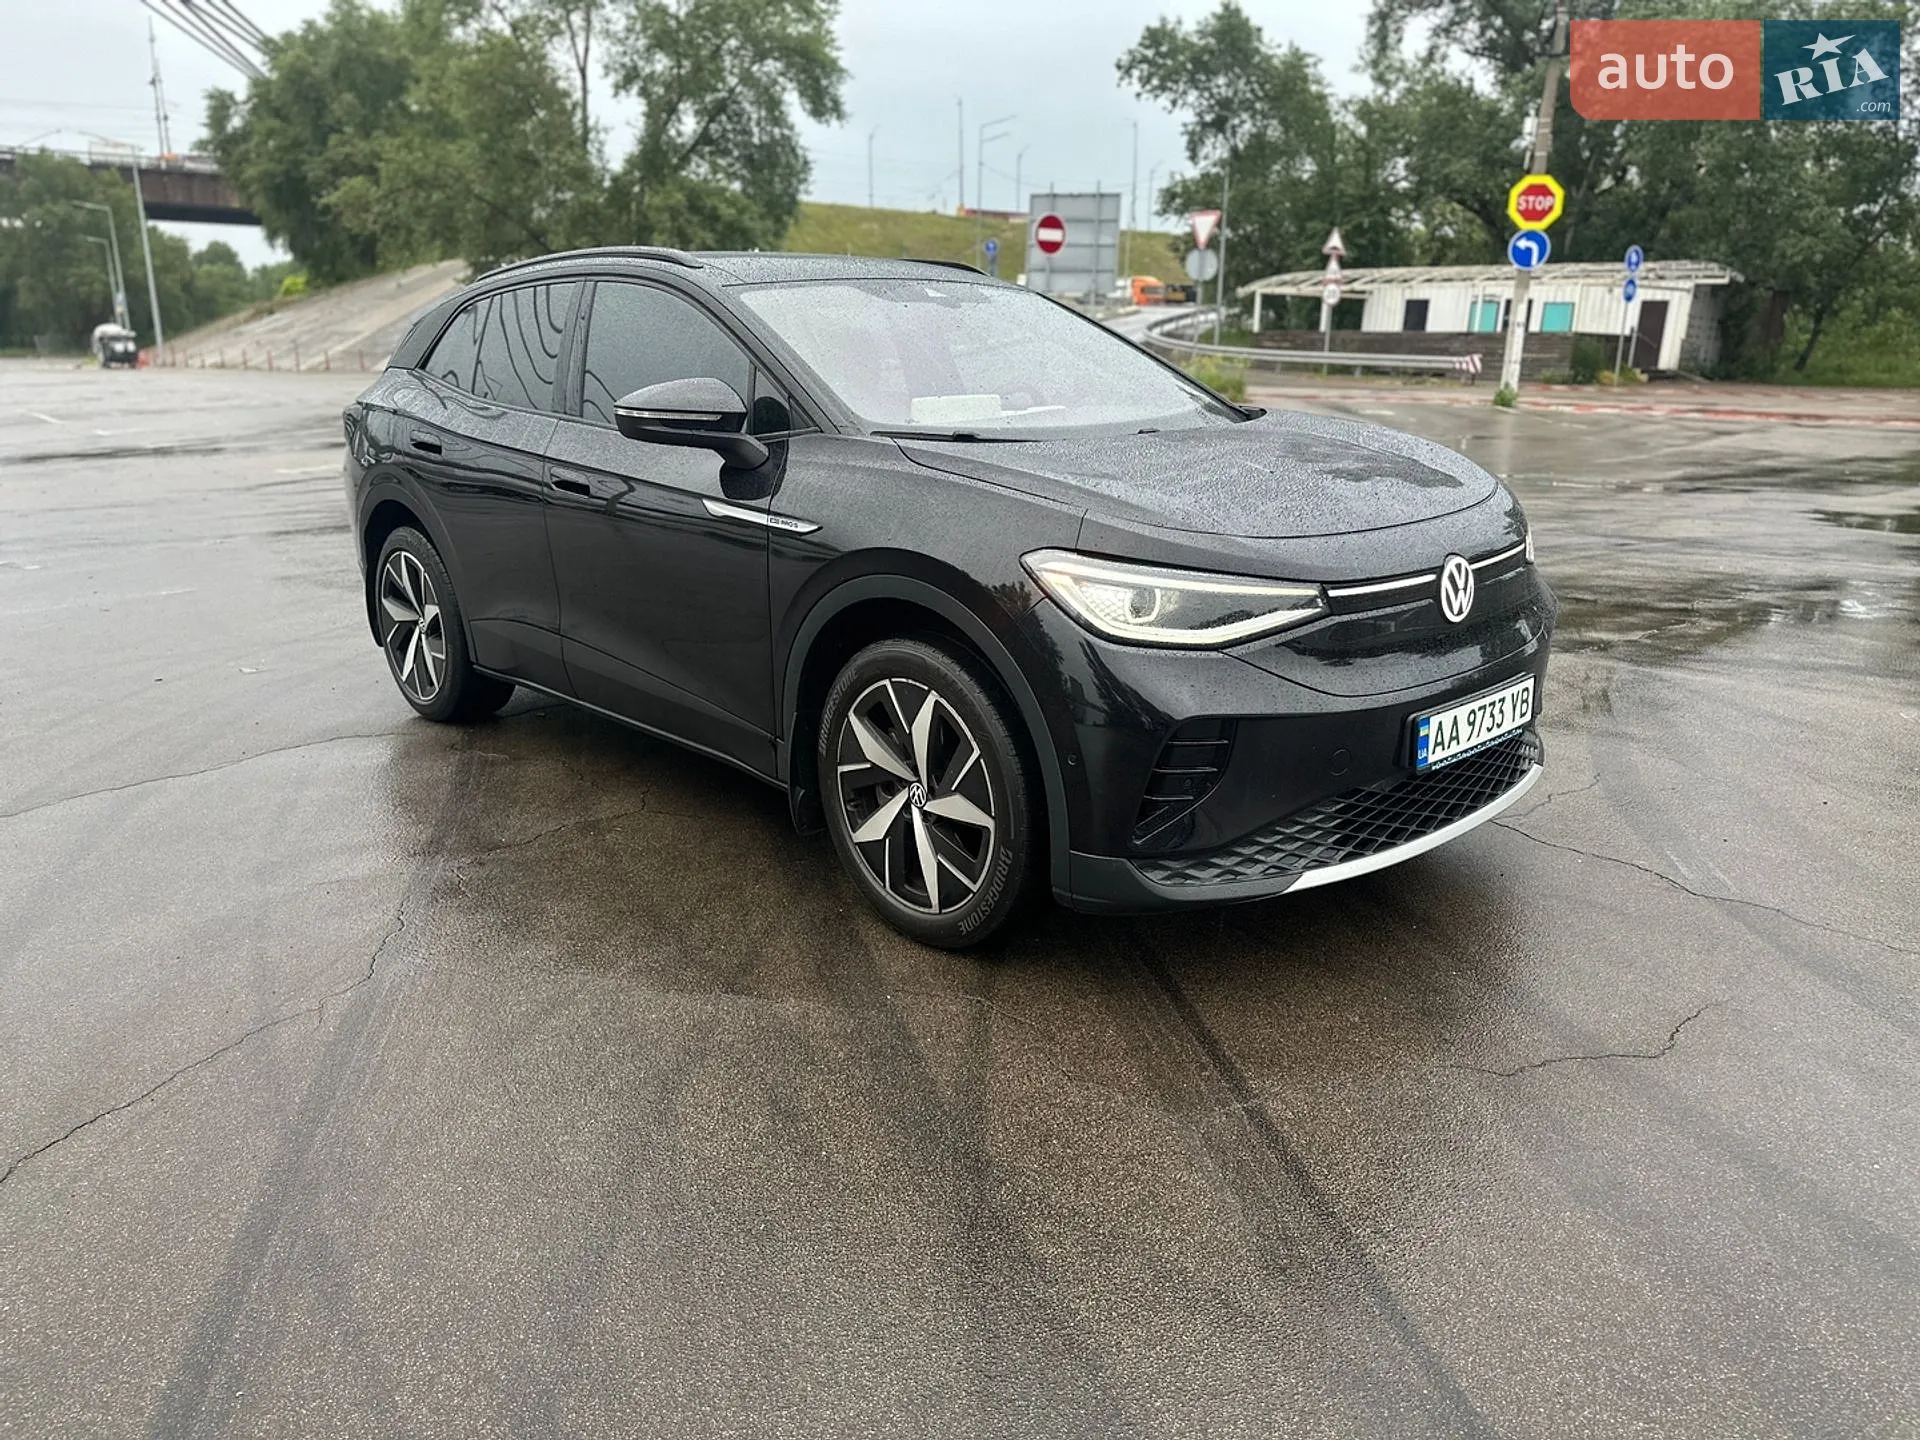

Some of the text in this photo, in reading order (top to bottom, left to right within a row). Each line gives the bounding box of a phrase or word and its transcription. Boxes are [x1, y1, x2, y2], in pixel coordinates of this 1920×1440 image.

[1518, 195, 1553, 211] STOP
[1432, 714, 1460, 755] AA
[1467, 696, 1506, 742] 9733
[1511, 687, 1530, 722] YB
[1418, 747, 1428, 759] UA
[958, 844, 1013, 936] BRIDGESTONE
